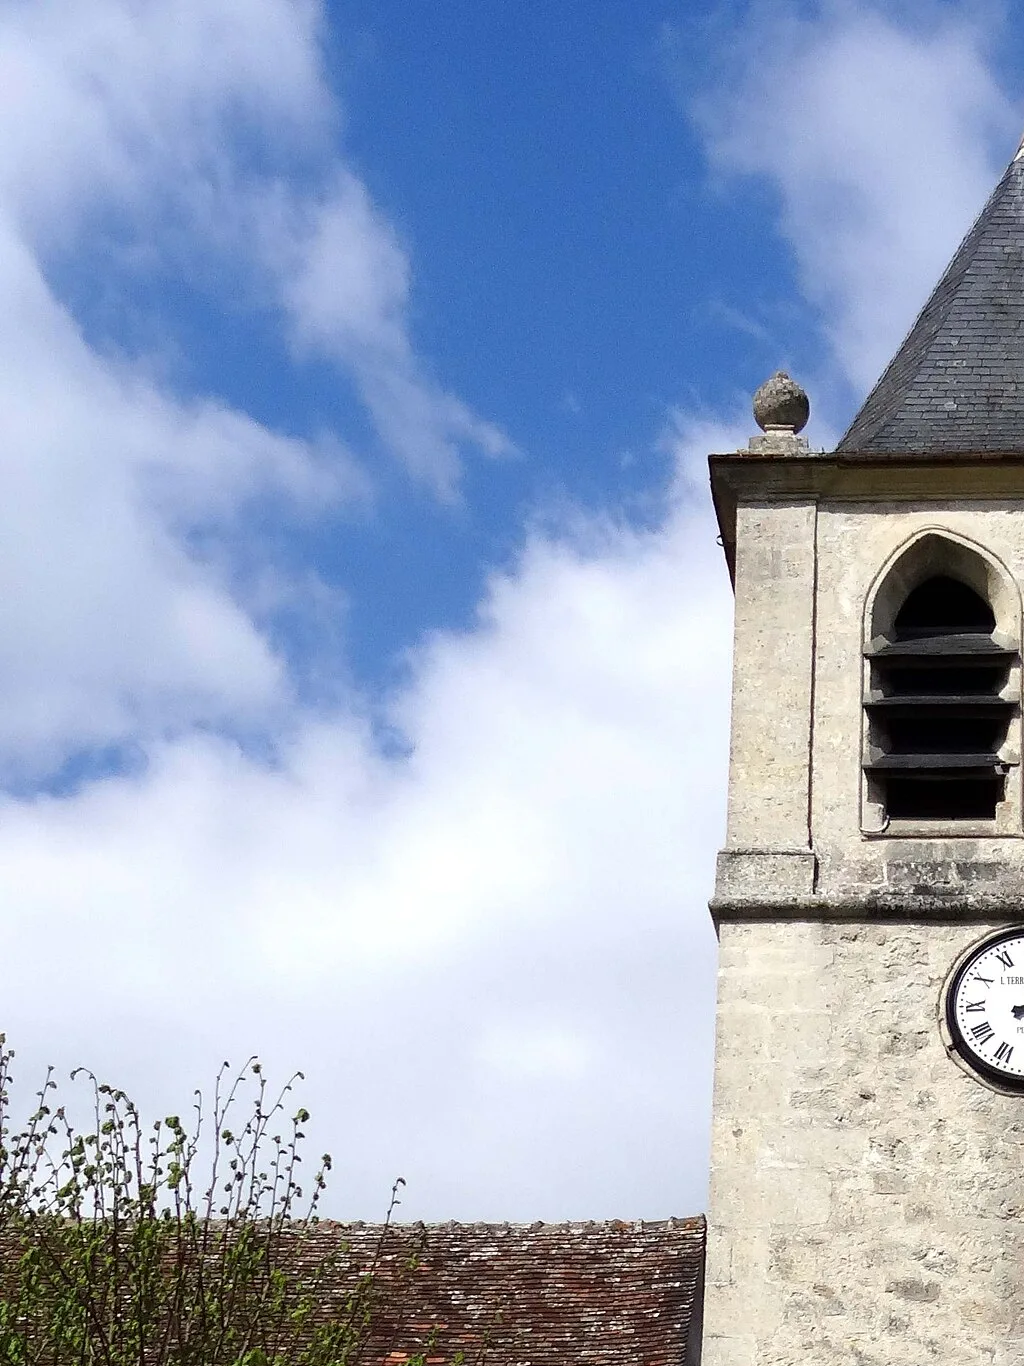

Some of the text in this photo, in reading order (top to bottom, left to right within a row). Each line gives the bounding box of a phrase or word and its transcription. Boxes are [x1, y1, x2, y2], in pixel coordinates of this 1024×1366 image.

[994, 950, 1015, 971] XI
[973, 972, 995, 989] X
[965, 1000, 986, 1012] IX
[970, 1021, 996, 1046] VIII
[993, 1041, 1015, 1064] VII
